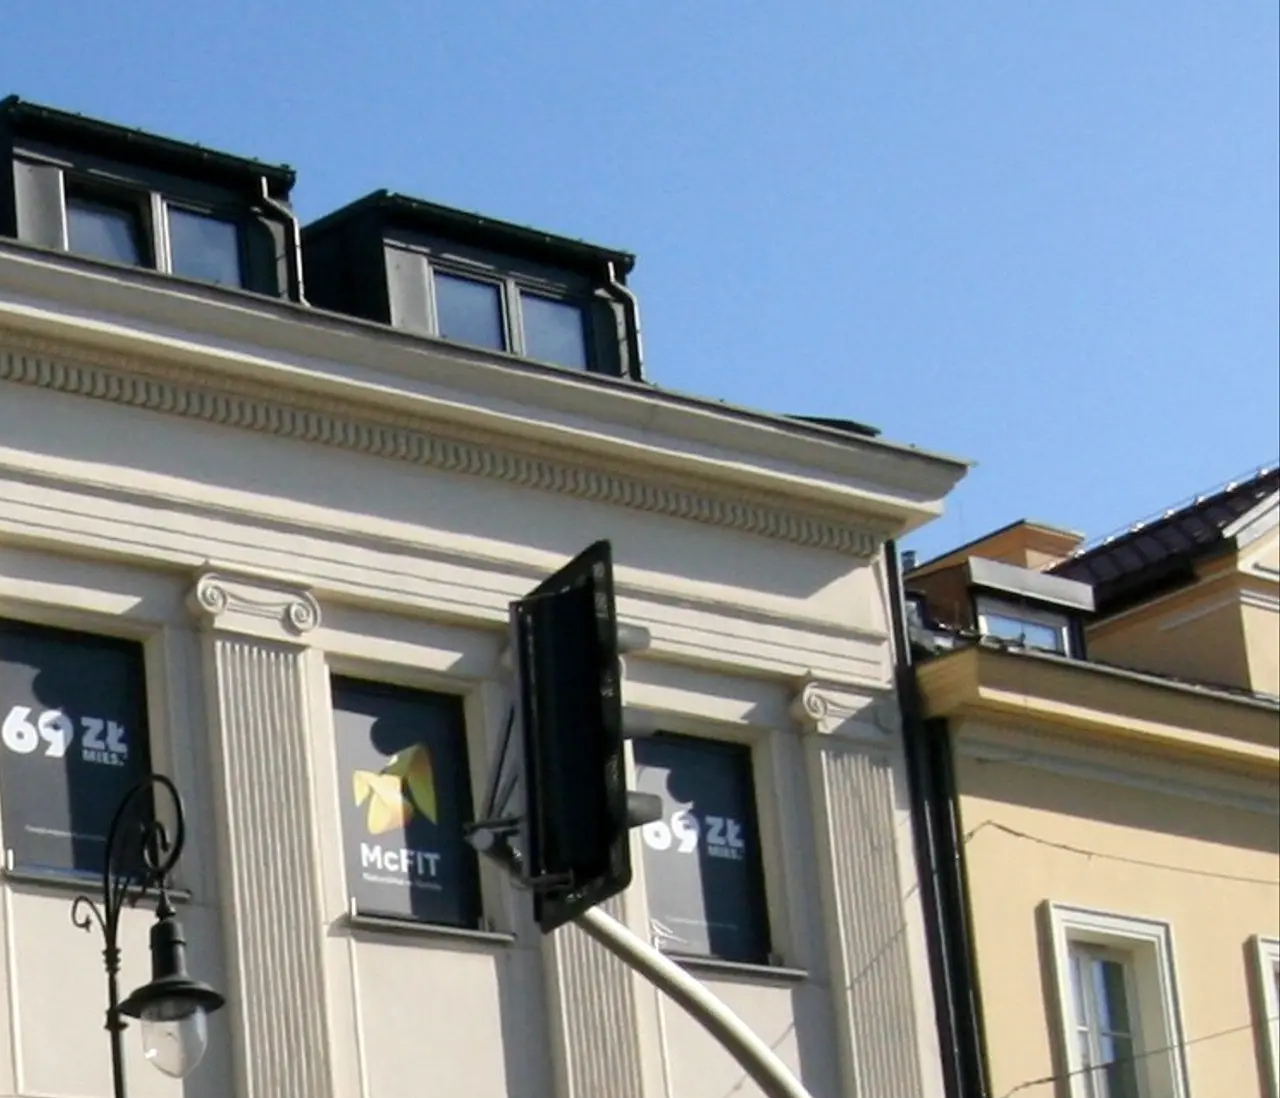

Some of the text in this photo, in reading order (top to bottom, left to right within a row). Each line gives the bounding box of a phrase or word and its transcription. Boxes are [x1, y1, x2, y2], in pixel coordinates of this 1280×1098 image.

[0, 705, 128, 758] 69 ZŁ
[705, 814, 745, 848] ZŁ
[360, 842, 441, 877] McFIT
